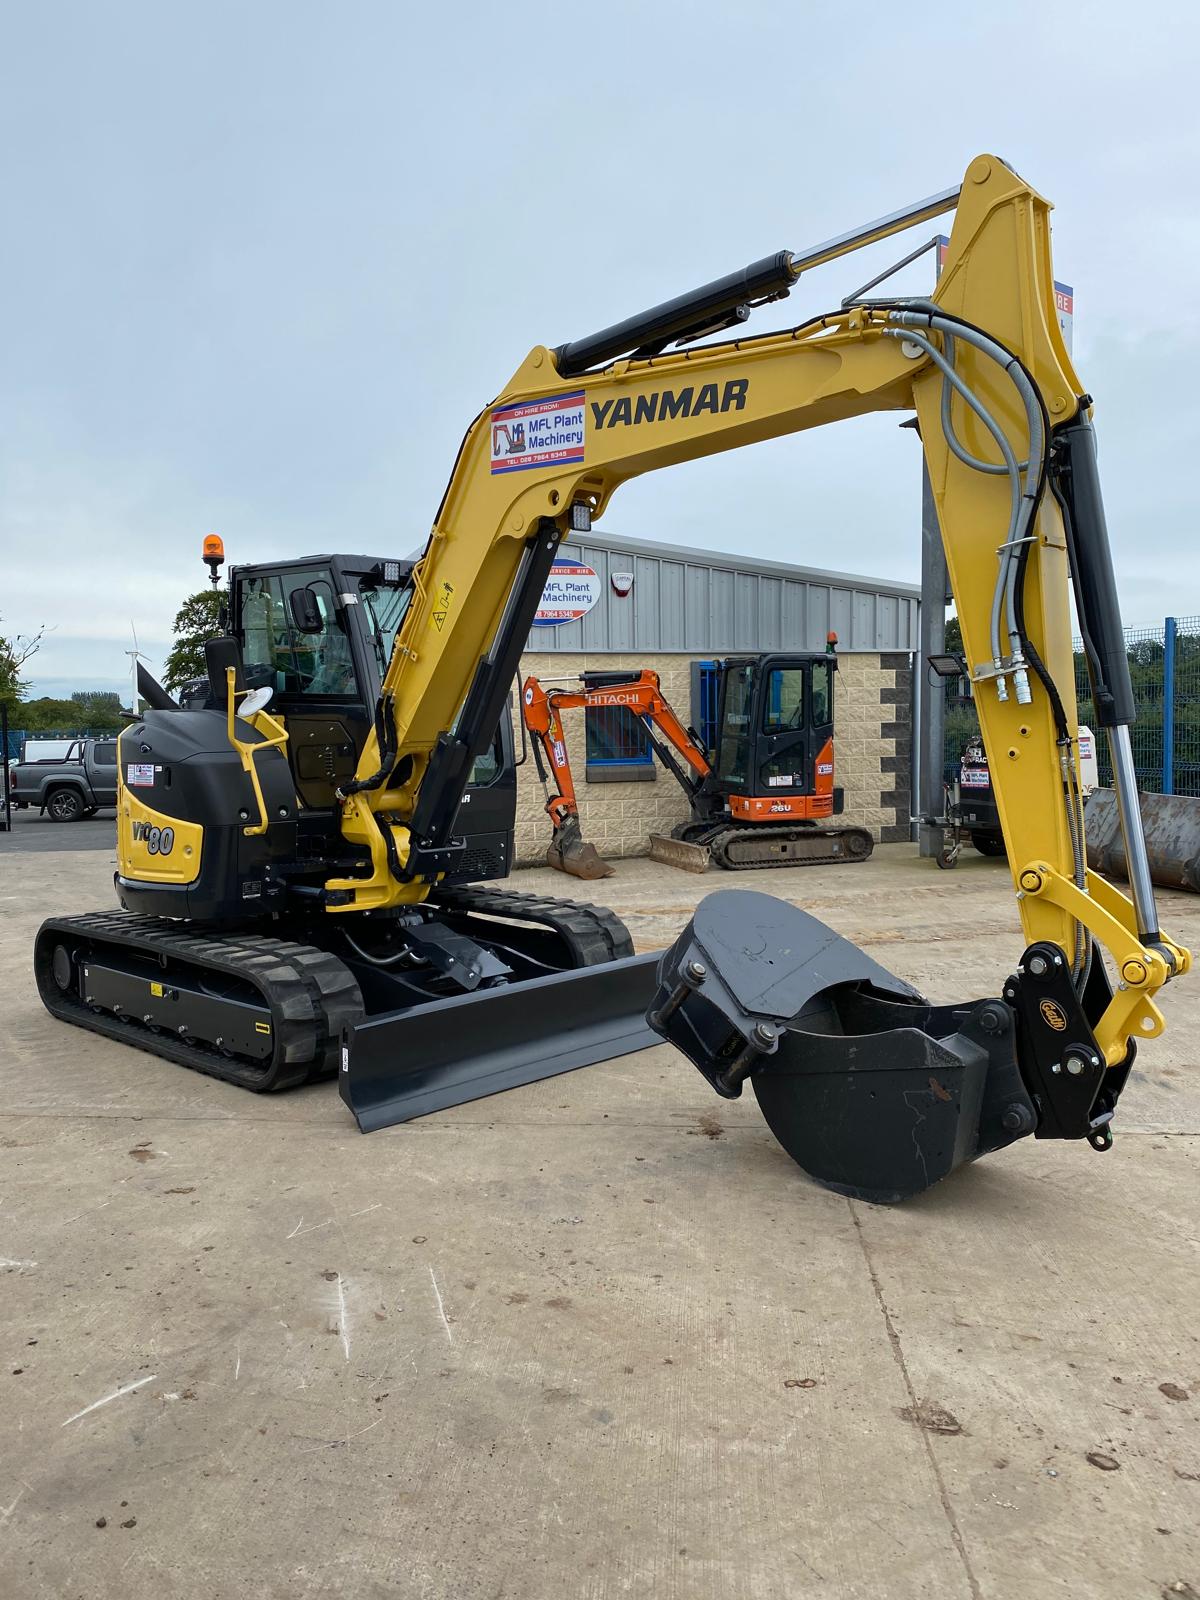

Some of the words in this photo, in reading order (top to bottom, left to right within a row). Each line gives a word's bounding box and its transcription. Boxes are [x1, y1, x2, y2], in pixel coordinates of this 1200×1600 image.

[591, 378, 749, 430] YANMAR
[524, 407, 539, 415] HIRE
[529, 418, 551, 433] MFL
[554, 411, 583, 428] Plant
[528, 431, 583, 449] Machinery
[544, 583, 563, 592] MFL
[565, 583, 590, 592] Plant
[542, 593, 593, 603] Machinery
[588, 694, 639, 704] HITACHI
[770, 804, 791, 812] 26U
